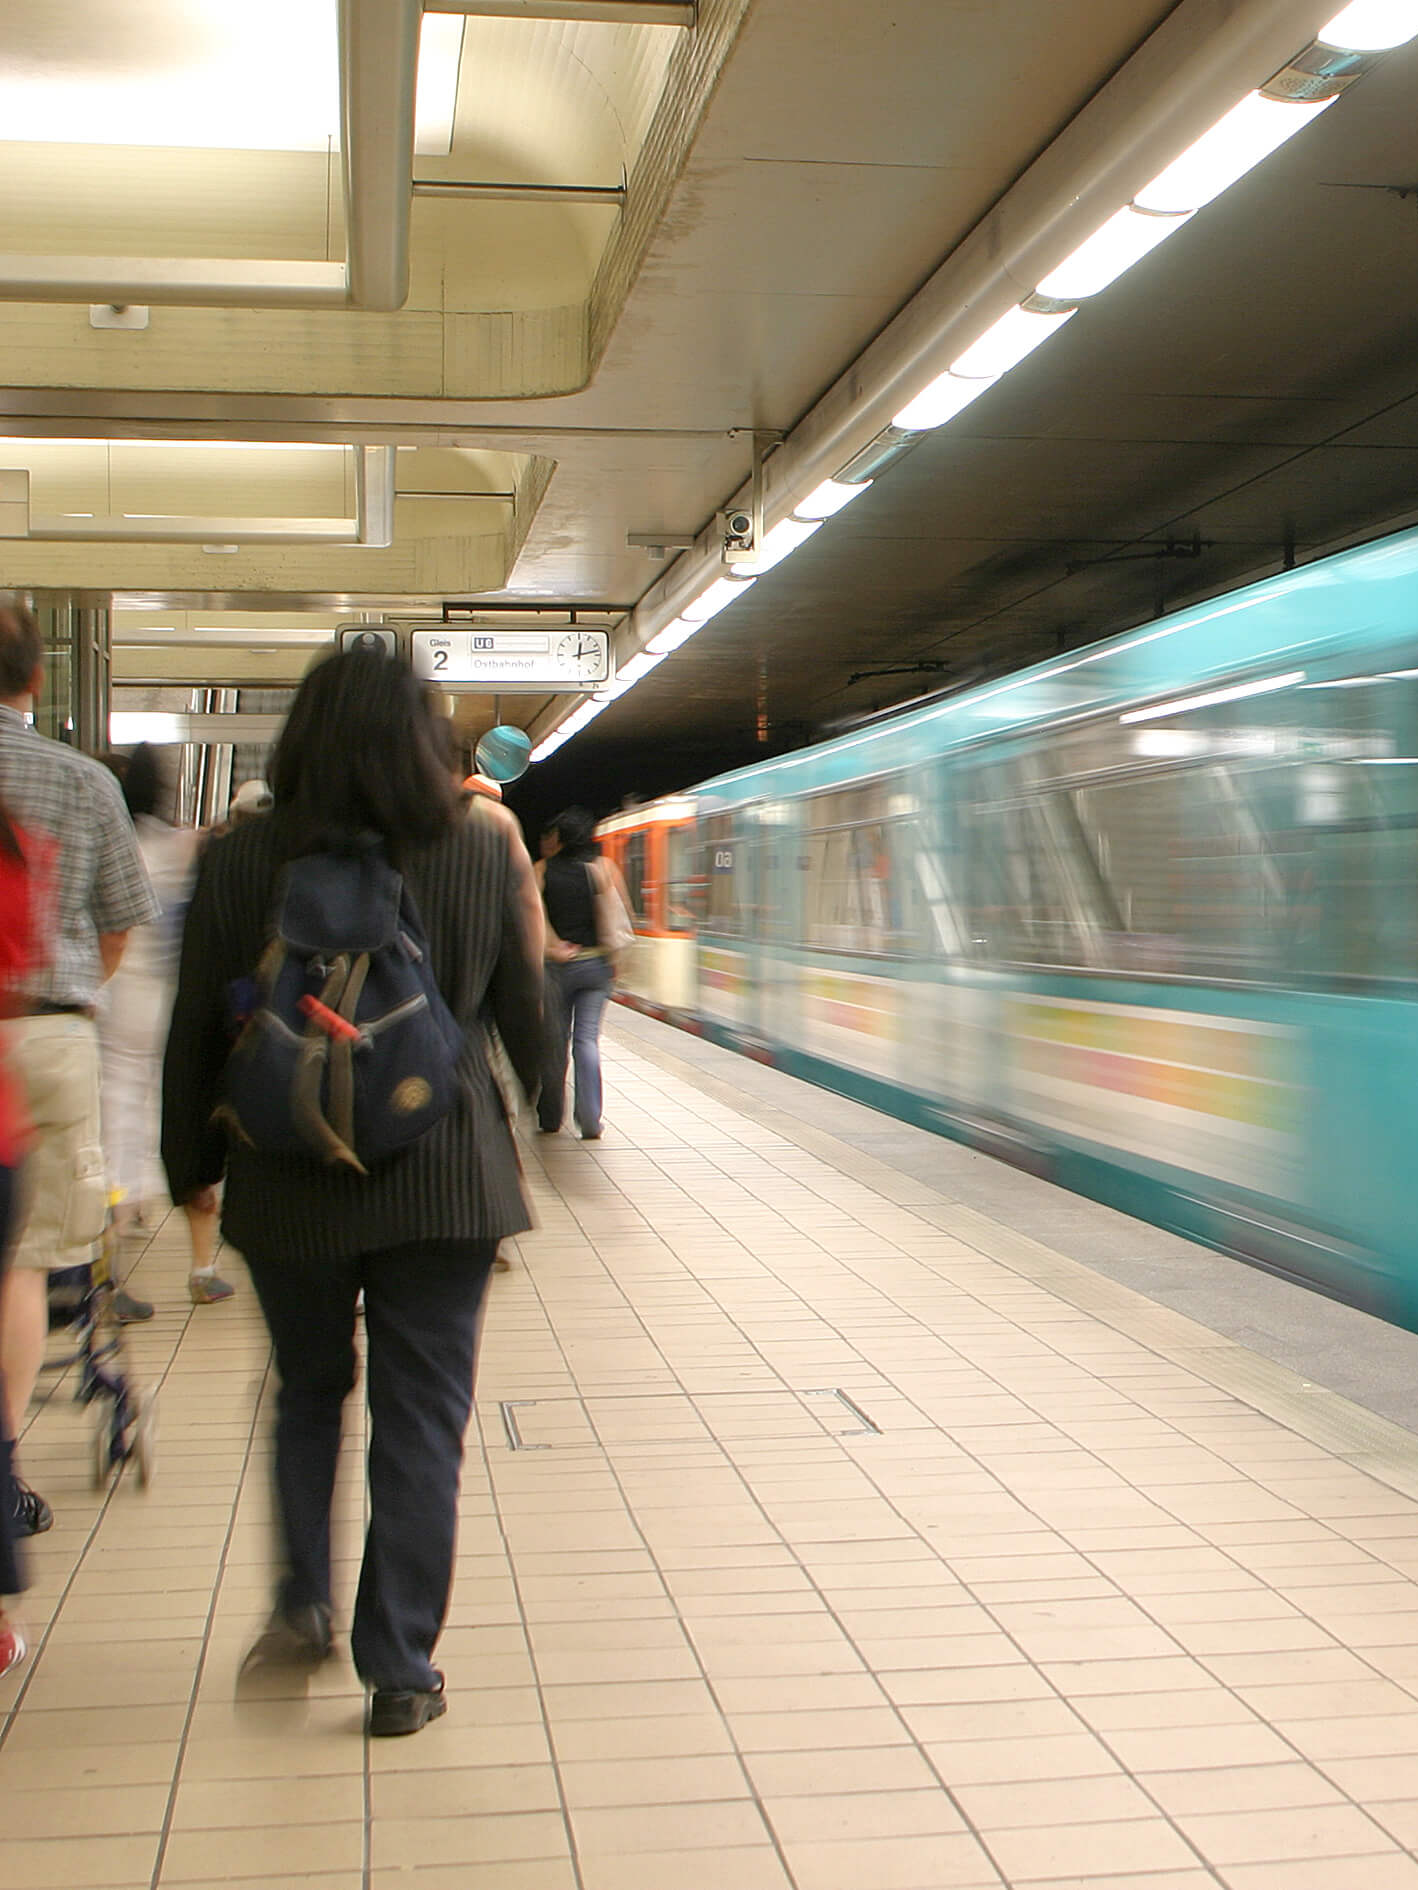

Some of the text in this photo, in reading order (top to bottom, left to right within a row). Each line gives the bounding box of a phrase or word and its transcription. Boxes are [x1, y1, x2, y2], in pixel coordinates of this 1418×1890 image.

[430, 638, 451, 647] Gleis
[434, 651, 448, 670] 2
[474, 659, 534, 669] Ostbahnhof
